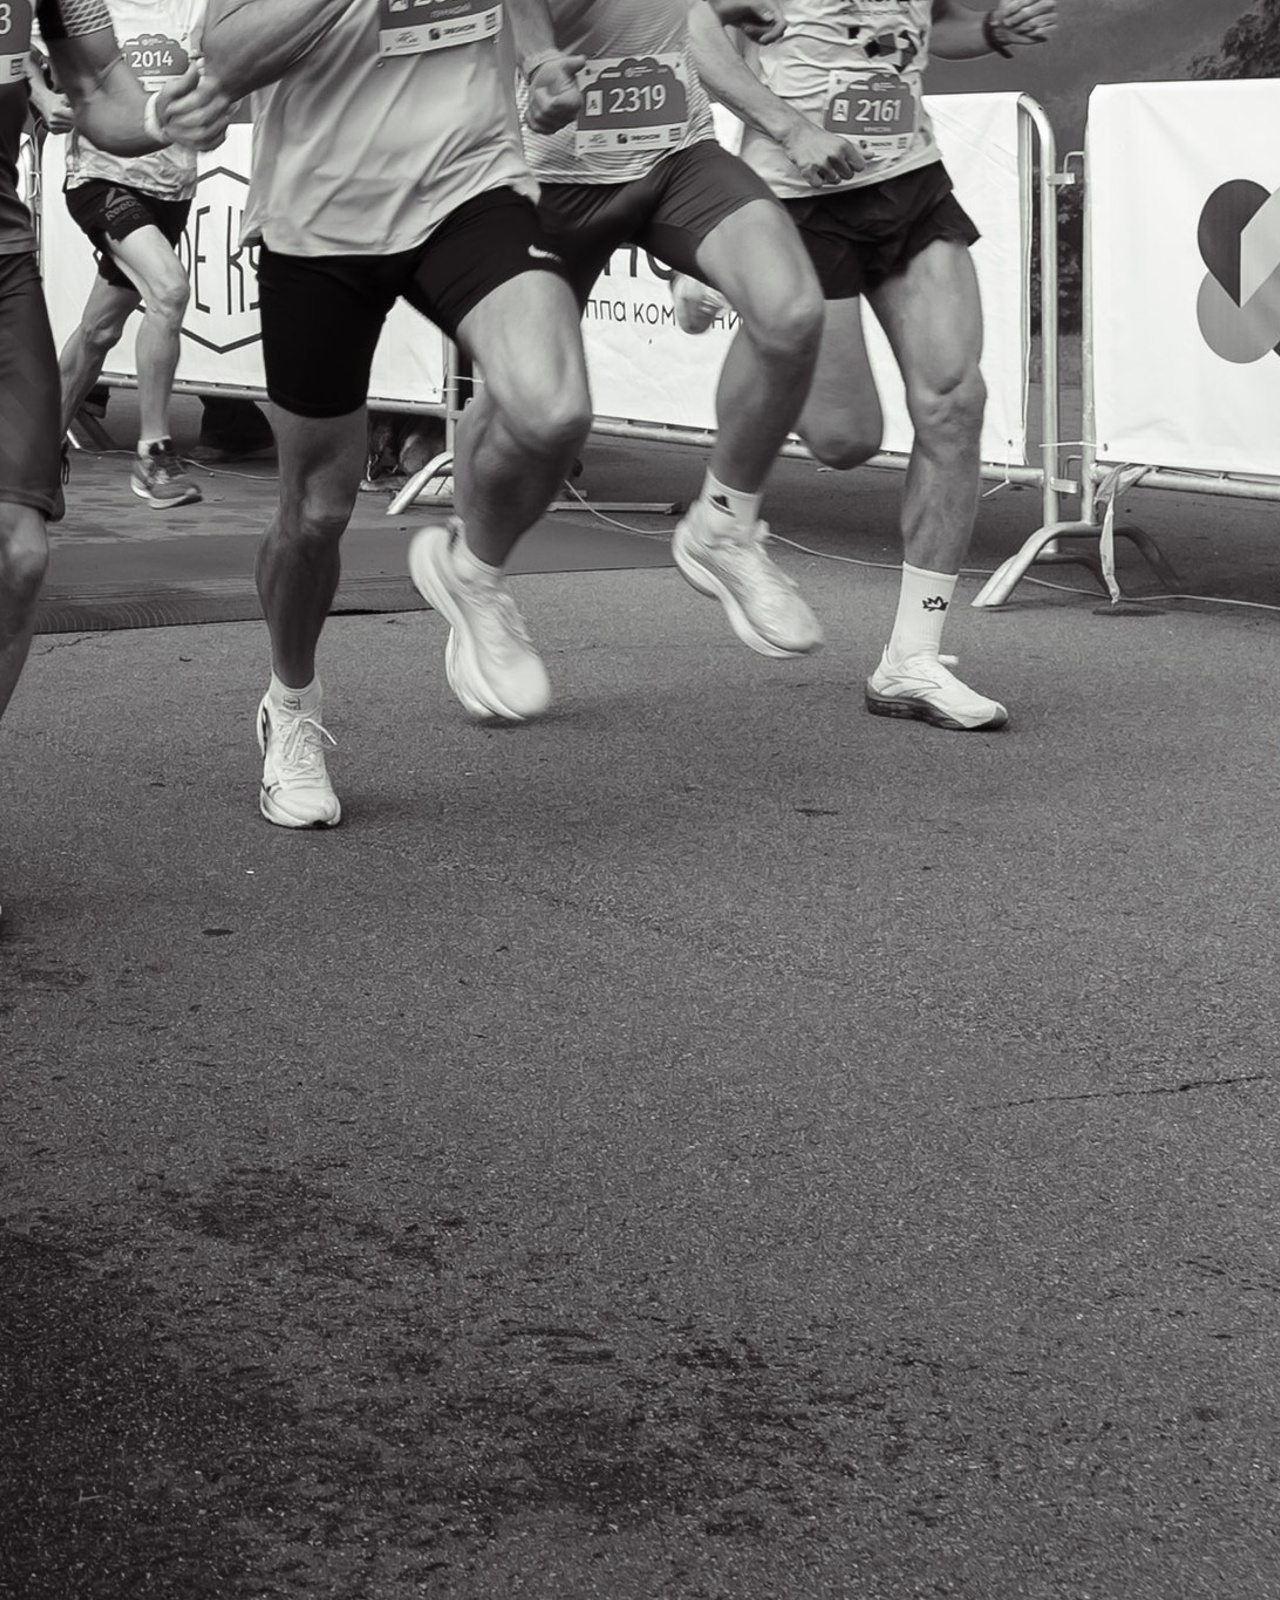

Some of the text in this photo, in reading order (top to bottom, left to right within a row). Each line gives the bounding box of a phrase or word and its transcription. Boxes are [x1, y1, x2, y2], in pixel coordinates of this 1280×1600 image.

[131, 50, 174, 68] 2014
[609, 83, 667, 114] 2319
[855, 99, 902, 122] 2161
